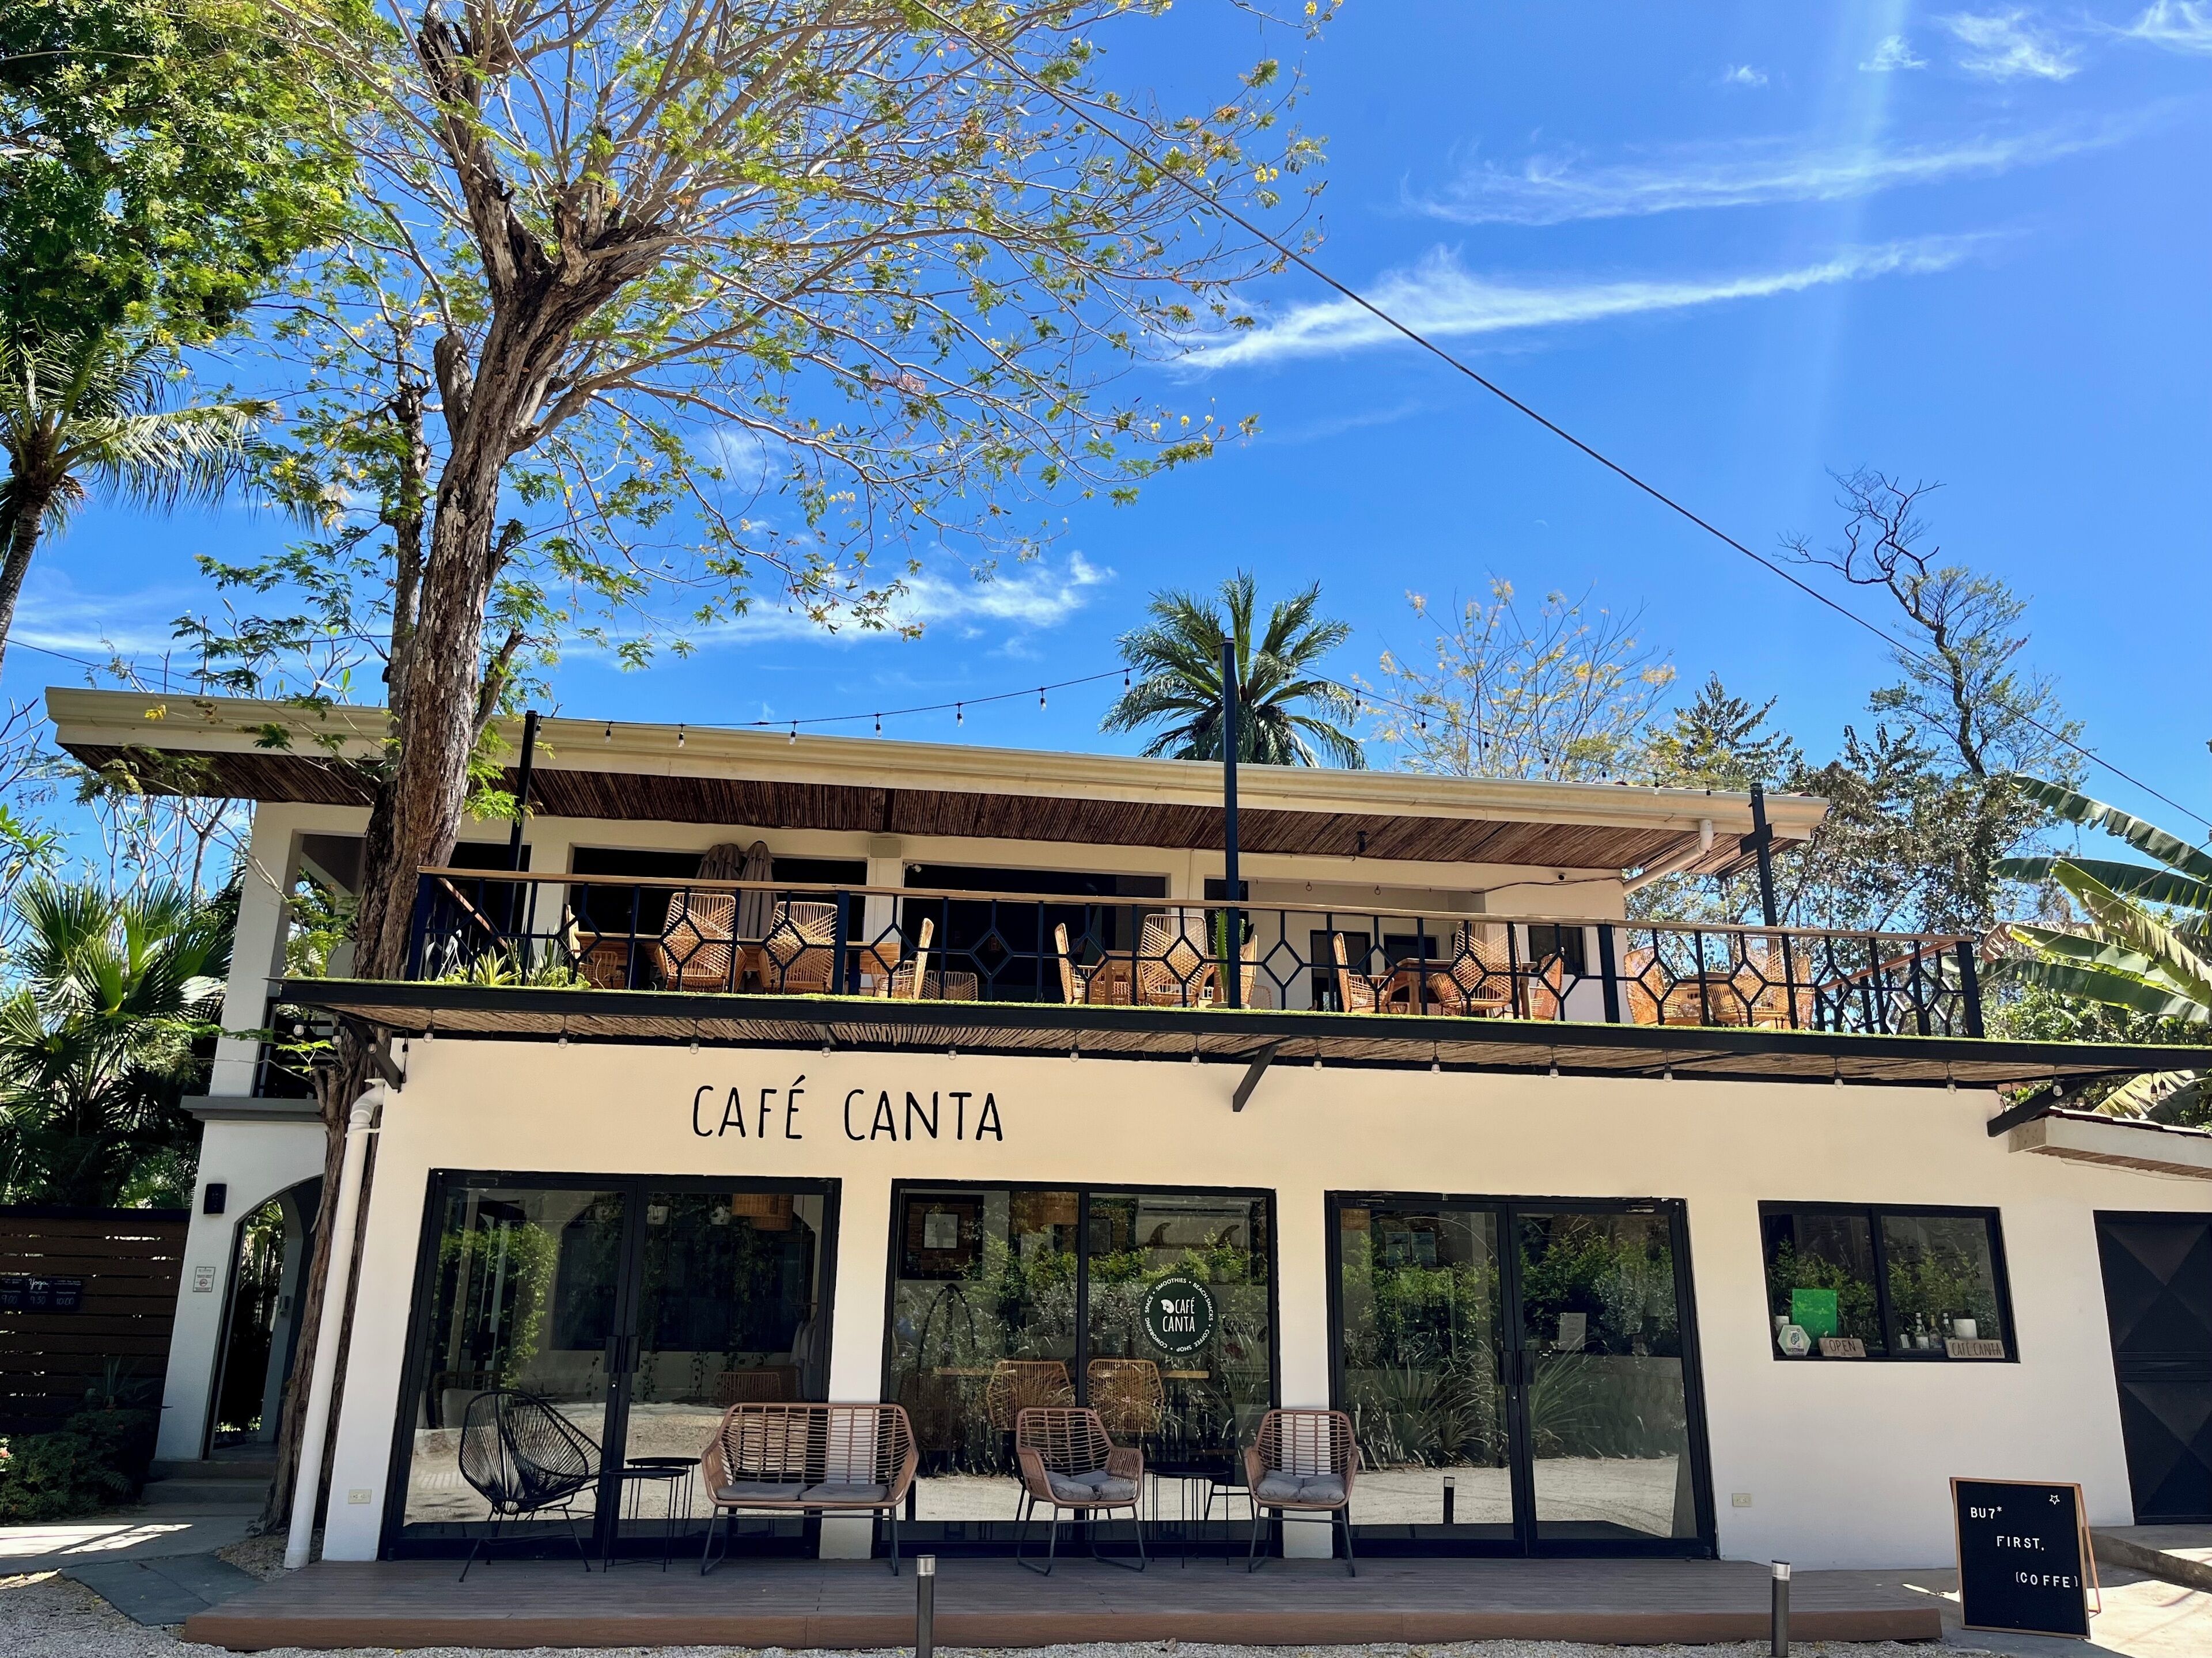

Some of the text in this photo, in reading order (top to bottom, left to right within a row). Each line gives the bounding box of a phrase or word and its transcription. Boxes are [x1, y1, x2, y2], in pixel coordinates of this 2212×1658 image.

[692, 1073, 1003, 1142] CAFÉ CANTA
[1175, 1296, 1195, 1314] CAFÉ
[1144, 1277, 1214, 1352] SMOOTHIES BEACH SNACKS COFFEE SHOP COWORKING SPACE
[1162, 1315, 1195, 1333] CANTA
[1828, 1339, 1857, 1352] OPEN
[1973, 1342, 2002, 1356] CANTA
[1997, 1535, 2045, 1551] FIRST.
